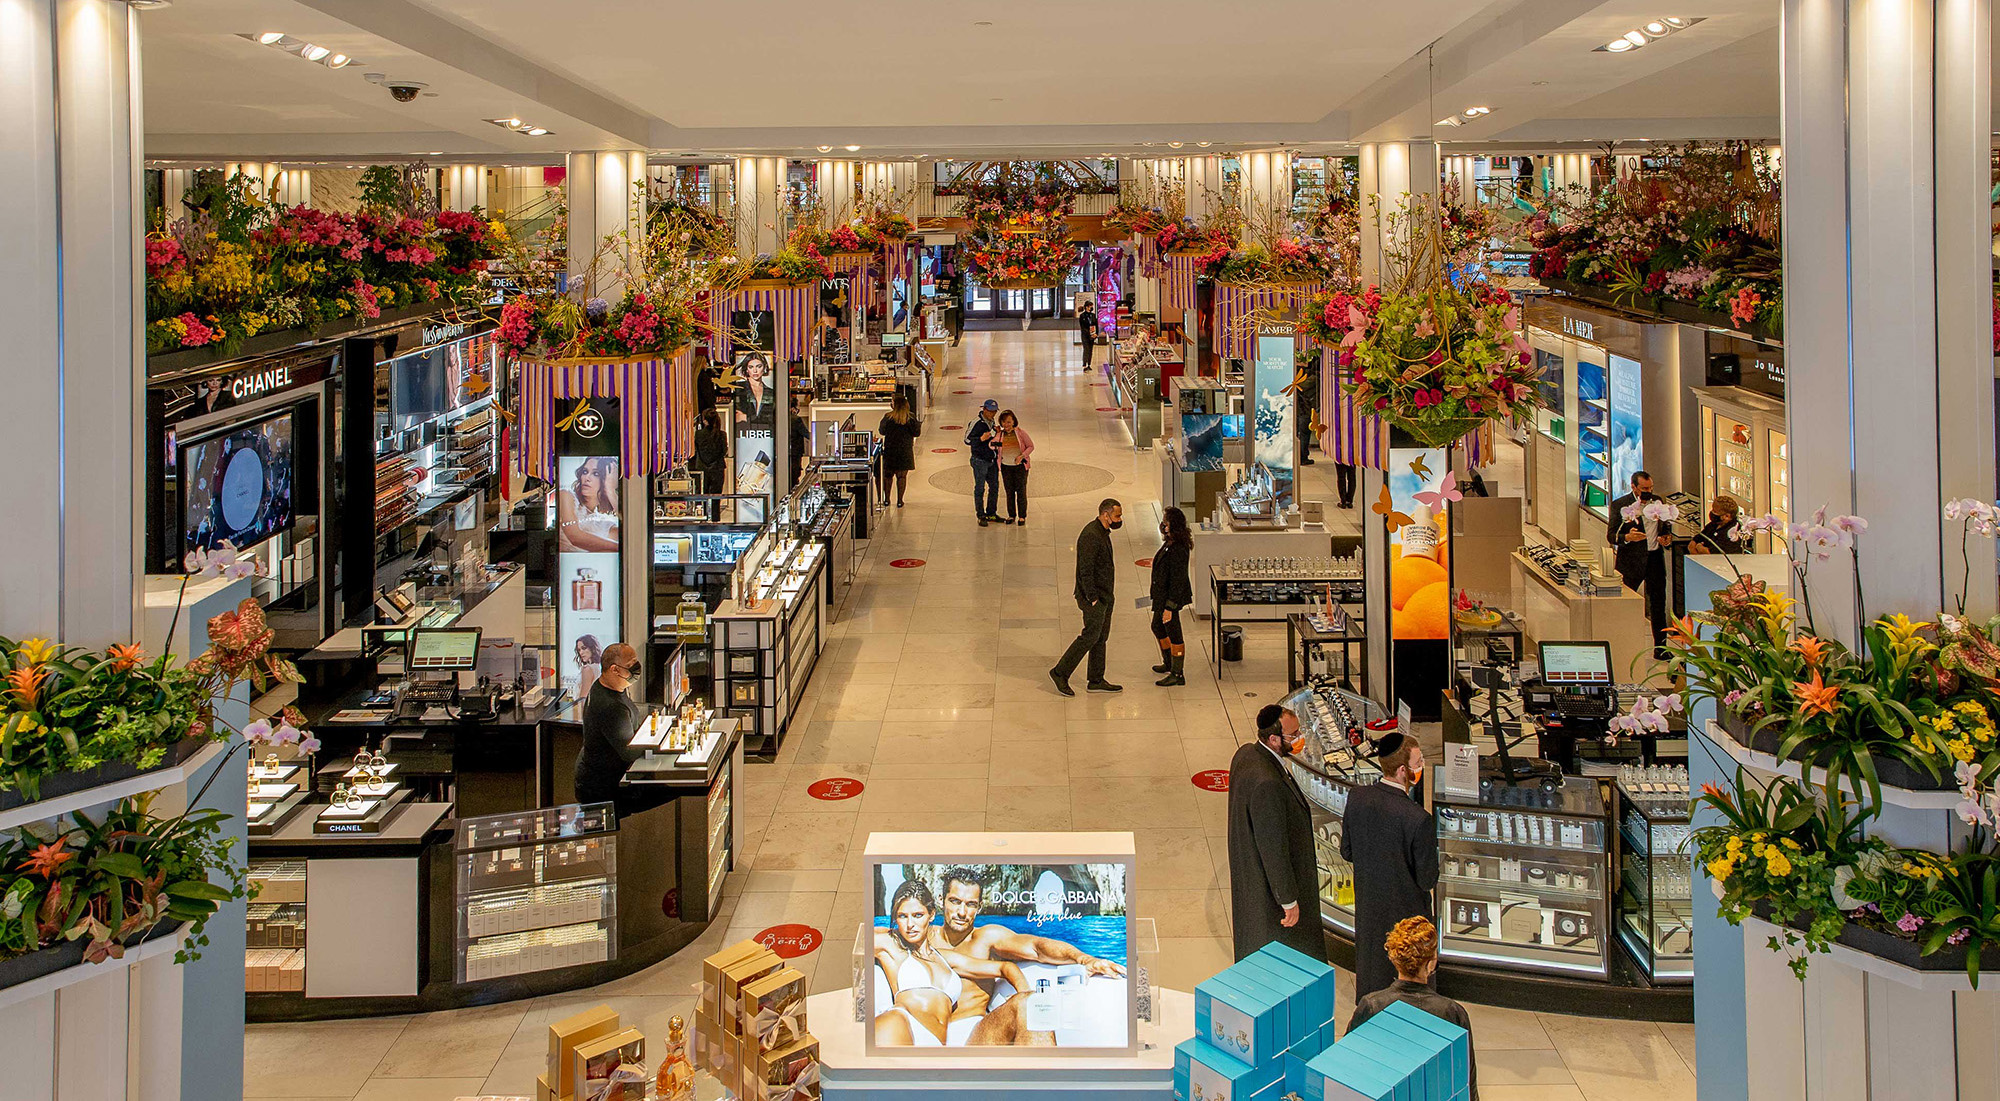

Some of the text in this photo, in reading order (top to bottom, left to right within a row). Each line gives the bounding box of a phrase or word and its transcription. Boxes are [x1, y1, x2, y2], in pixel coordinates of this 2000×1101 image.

[1257, 326, 1294, 335] LA MER
[1563, 316, 1594, 341] LA MER
[233, 366, 292, 398] CHANEL
[740, 429, 771, 439] LIBRE
[992, 890, 1036, 904] DOLCE
[1047, 890, 1118, 904] GABBANA
[1026, 906, 1083, 927] light blue
